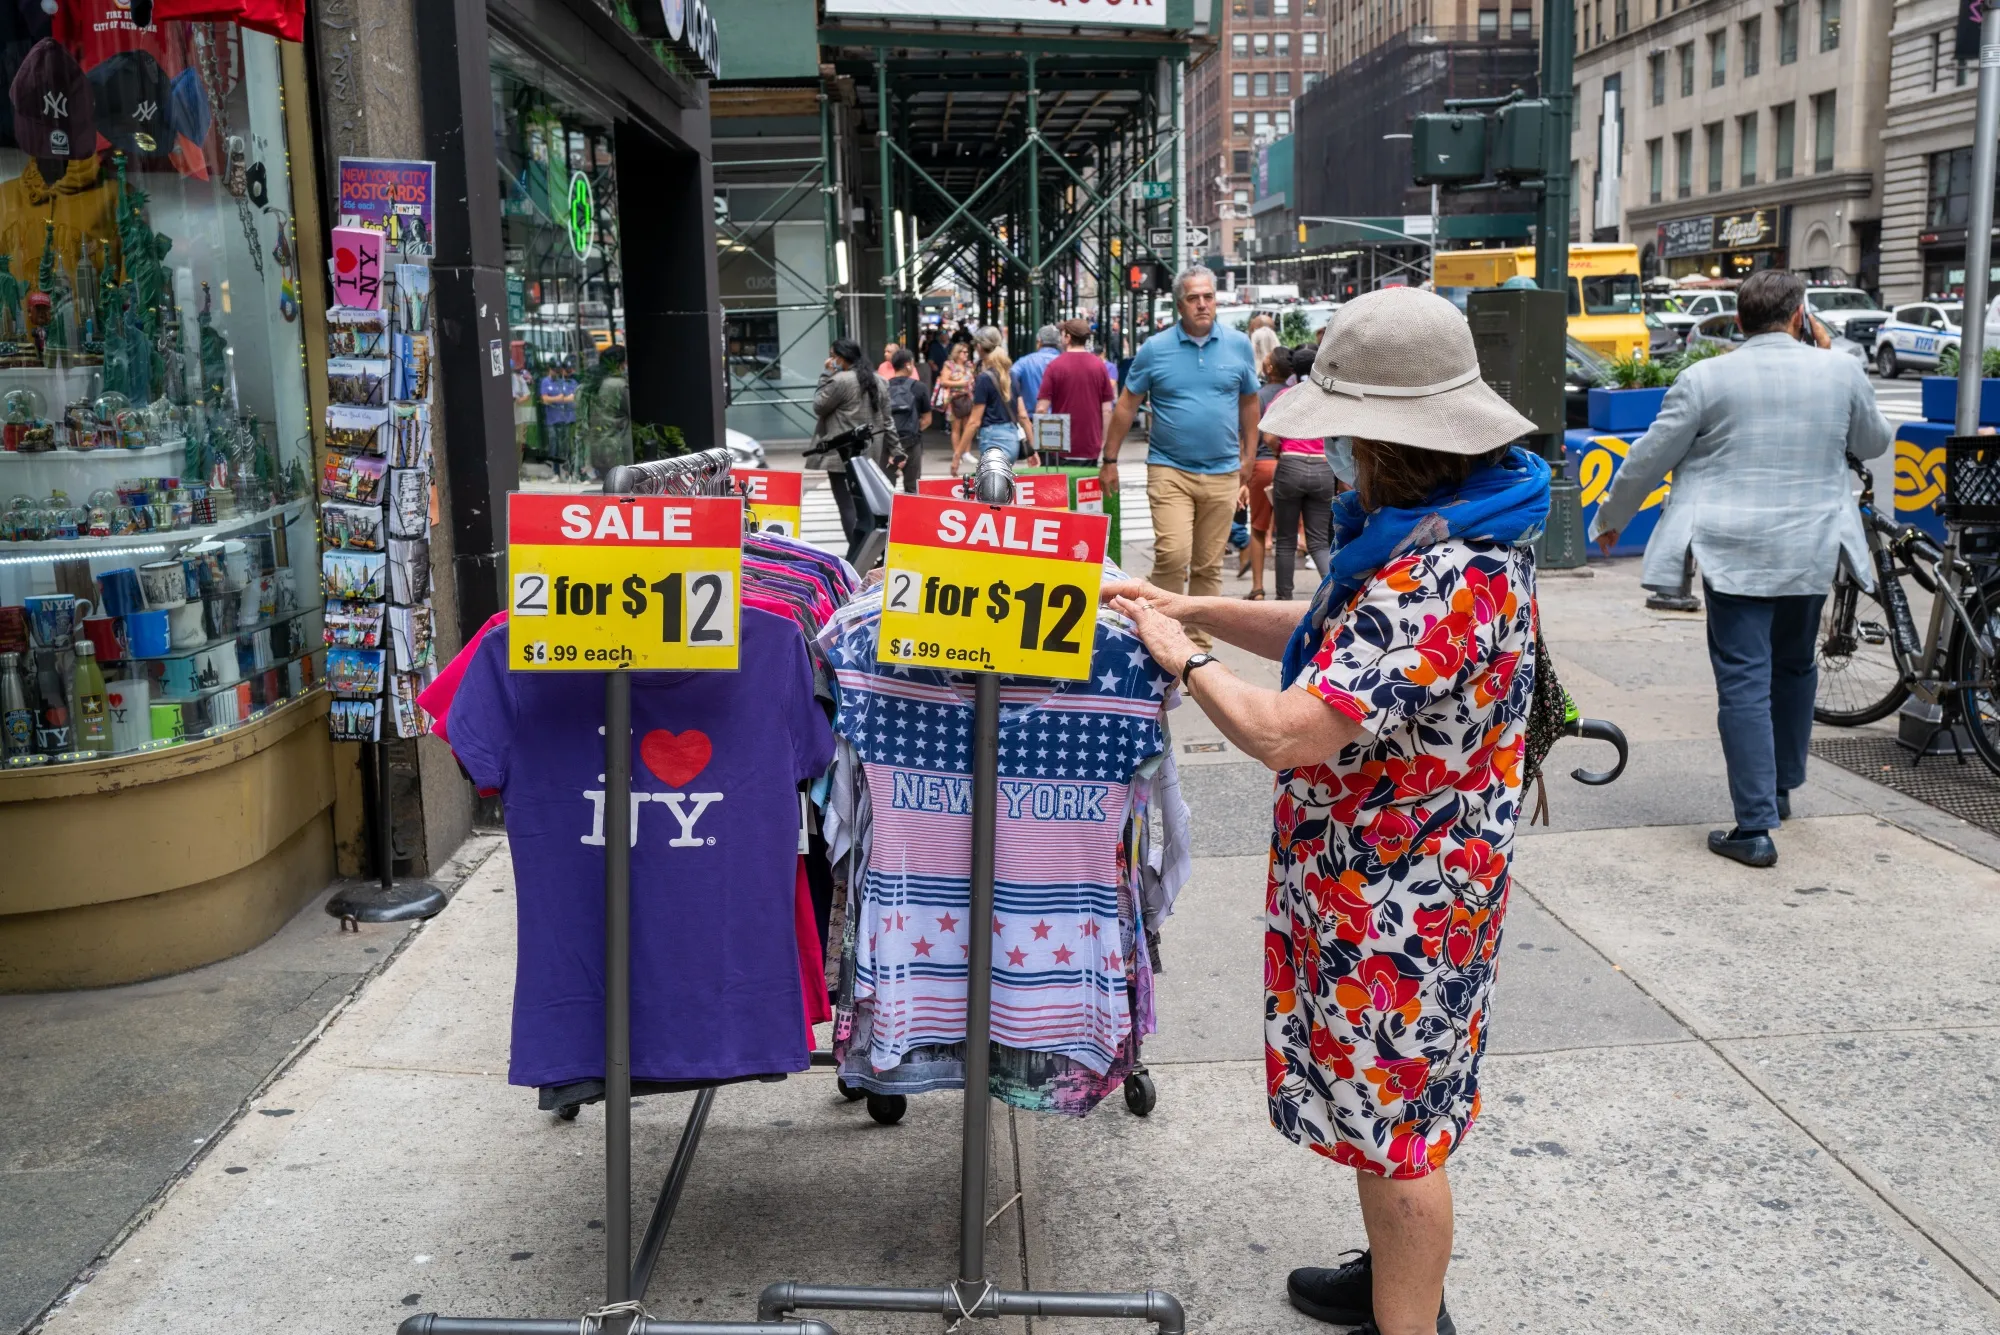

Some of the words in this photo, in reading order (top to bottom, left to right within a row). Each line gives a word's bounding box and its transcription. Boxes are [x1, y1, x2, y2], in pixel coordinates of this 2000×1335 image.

[106, 10, 122, 19] FIRE
[93, 22, 109, 32] CITY
[110, 21, 118, 29] OF
[120, 20, 137, 30] NEW
[342, 167, 367, 182] NEW
[369, 169, 400, 183] YORK
[402, 171, 428, 185] CITY
[342, 182, 426, 203] POSTCARDS
[1152, 183, 1164, 197] 36
[1155, 234, 1173, 242] ONE
[359, 244, 378, 298] NY
[337, 275, 357, 290] I
[560, 504, 693, 541] SALE
[937, 509, 1061, 554] SALE
[515, 575, 548, 610] 2
[554, 576, 613, 616] for
[622, 572, 724, 643] $12
[890, 573, 912, 609] 2
[924, 576, 980, 618] for
[986, 579, 1088, 655] $12
[523, 643, 578, 665] $6.99
[584, 645, 634, 662] each
[889, 637, 941, 660] $6.99
[945, 646, 992, 664] each
[330, 701, 375, 734] NYC
[36, 726, 70, 748] NY
[892, 771, 974, 815] NEW
[1000, 781, 1109, 822] YORK
